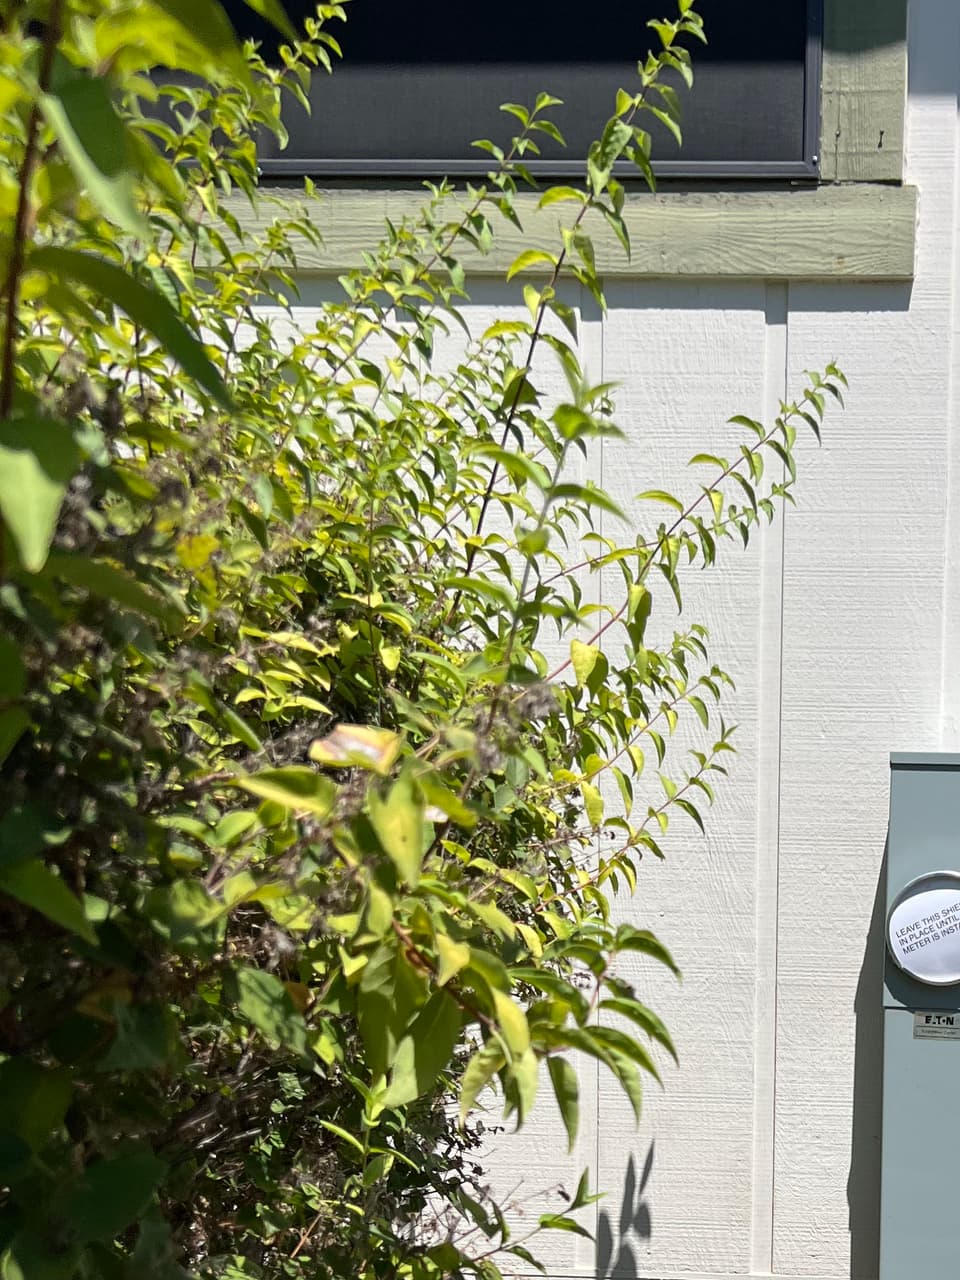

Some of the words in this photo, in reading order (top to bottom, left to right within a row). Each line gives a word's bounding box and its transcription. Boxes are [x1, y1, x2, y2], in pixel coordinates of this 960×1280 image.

[895, 921, 921, 938] LEAVE
[922, 912, 940, 926] THIS
[898, 937, 909, 946] IN
[908, 924, 935, 942] PLACE
[936, 914, 960, 930] UNTIL
[902, 936, 931, 955] METER
[931, 932, 940, 942] IS
